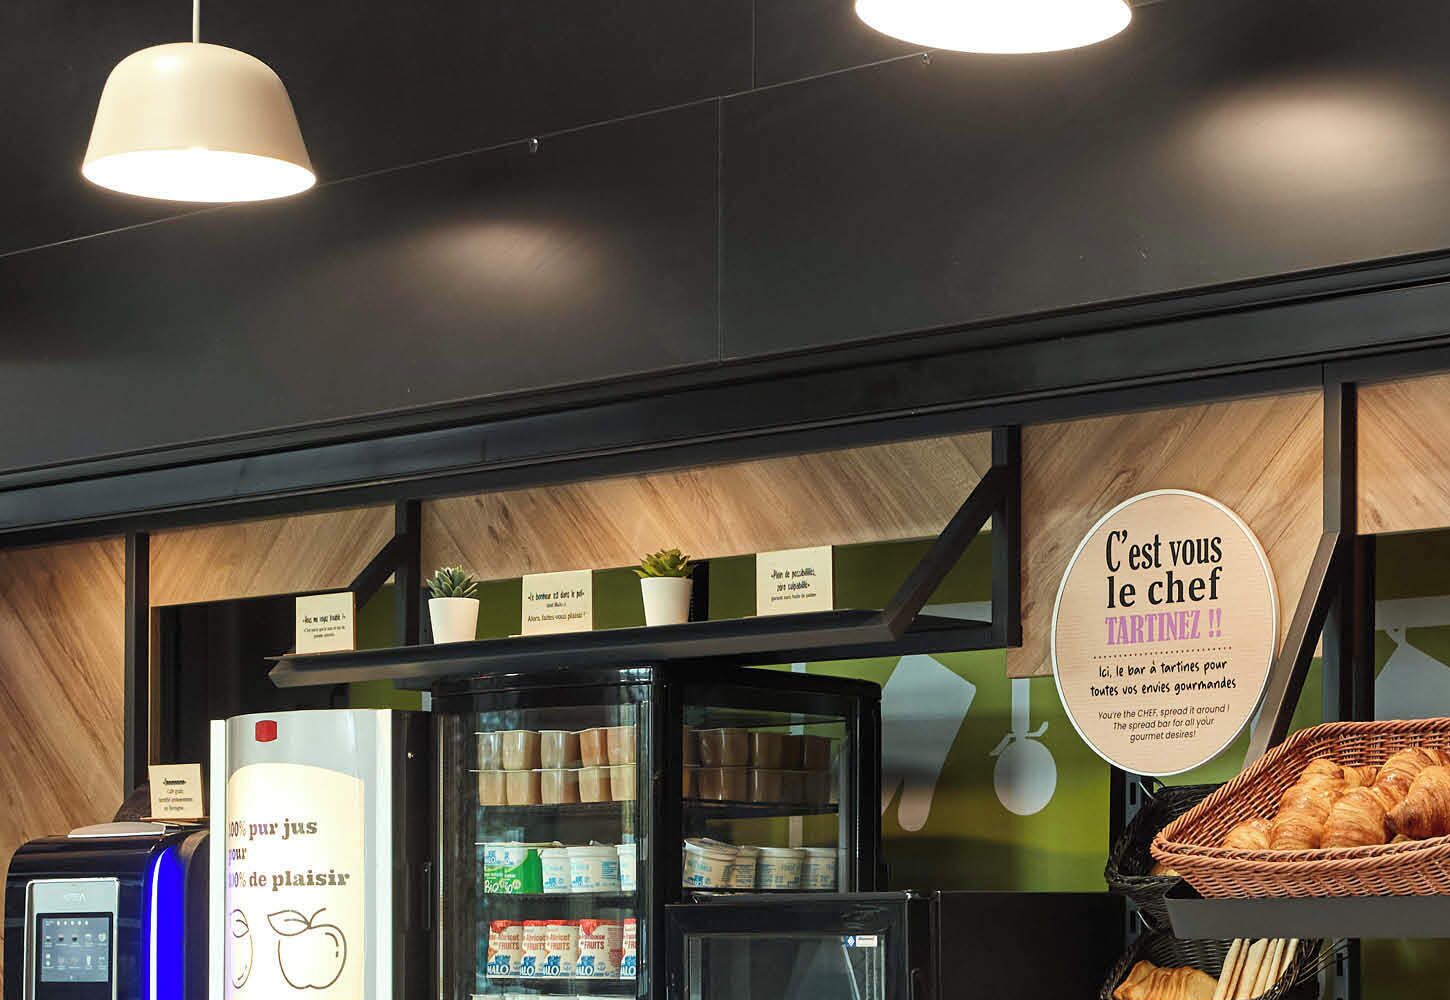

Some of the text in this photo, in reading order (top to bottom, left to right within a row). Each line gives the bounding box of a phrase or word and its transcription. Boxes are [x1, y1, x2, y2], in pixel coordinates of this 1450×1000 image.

[1105, 529, 1222, 572] C'est vous
[1107, 566, 1222, 608] le chef
[1104, 607, 1223, 646] TARTINEZ !!
[1098, 659, 1227, 679] Ici, le bar à tartines pour
[1090, 676, 1236, 697] toutes vos envies gourmandes
[1123, 708, 1136, 718] the
[1160, 705, 1188, 718] spread
[1189, 704, 1196, 715] it
[1196, 704, 1226, 715] around
[1113, 717, 1214, 732] The spread bar for all your
[1130, 730, 1196, 744] gourmet desires!
[248, 822, 278, 840] pur
[282, 818, 318, 840] jus
[249, 871, 267, 888] de
[272, 869, 350, 892] plaisir
[584, 941, 604, 950] FRUITS
